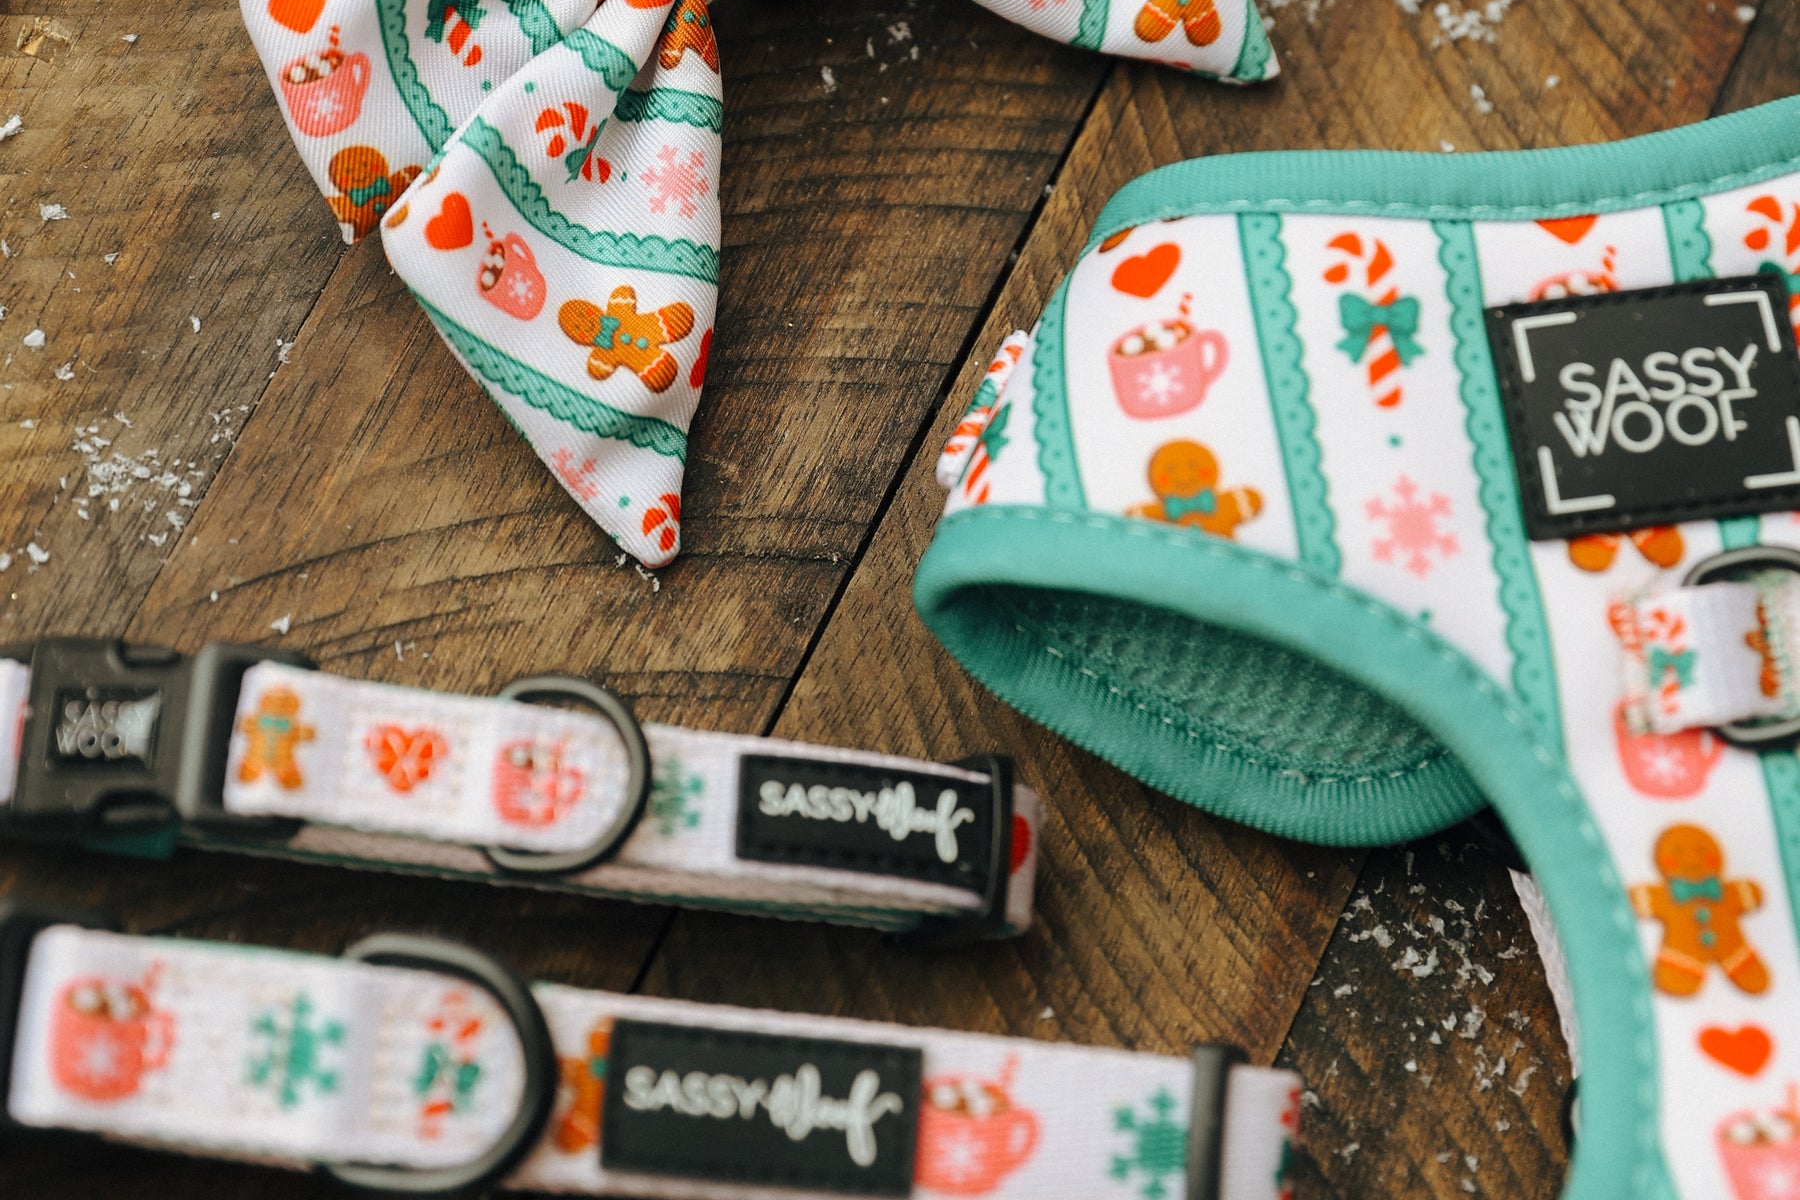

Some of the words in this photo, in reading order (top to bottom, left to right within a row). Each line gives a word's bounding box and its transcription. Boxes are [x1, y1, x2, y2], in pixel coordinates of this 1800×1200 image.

[1558, 343, 1759, 412] SASSY
[1553, 387, 1758, 458] WOOF
[56, 722, 144, 759] WOO
[758, 780, 878, 823] SASSY
[622, 1064, 768, 1120] SASSY
